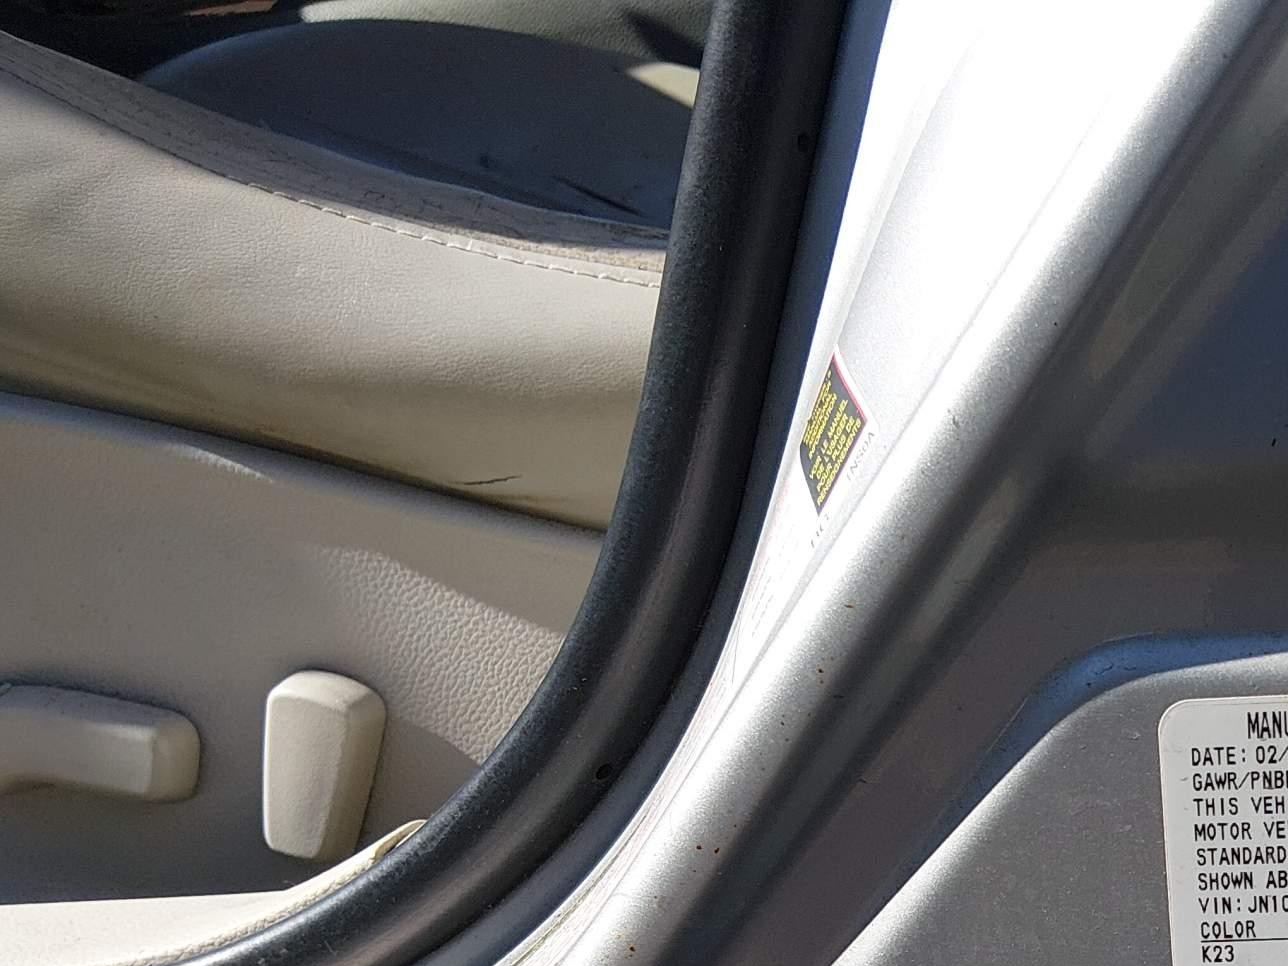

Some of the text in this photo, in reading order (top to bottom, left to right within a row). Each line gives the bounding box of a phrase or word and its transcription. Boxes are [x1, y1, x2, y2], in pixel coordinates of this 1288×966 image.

[809, 393, 837, 460] INFORMATION
[809, 455, 822, 480] VOIR
[821, 439, 829, 454] LE
[827, 399, 849, 439] MANUEL
[816, 416, 855, 492] POUR PLUS DE
[1191, 745, 1247, 767] DATE:
[1193, 796, 1239, 817] THIS
[1194, 821, 1252, 842] MOTOR
[1198, 871, 1254, 891] SHOWN
[1200, 920, 1257, 939] COLOR
[1201, 945, 1235, 963] K23
